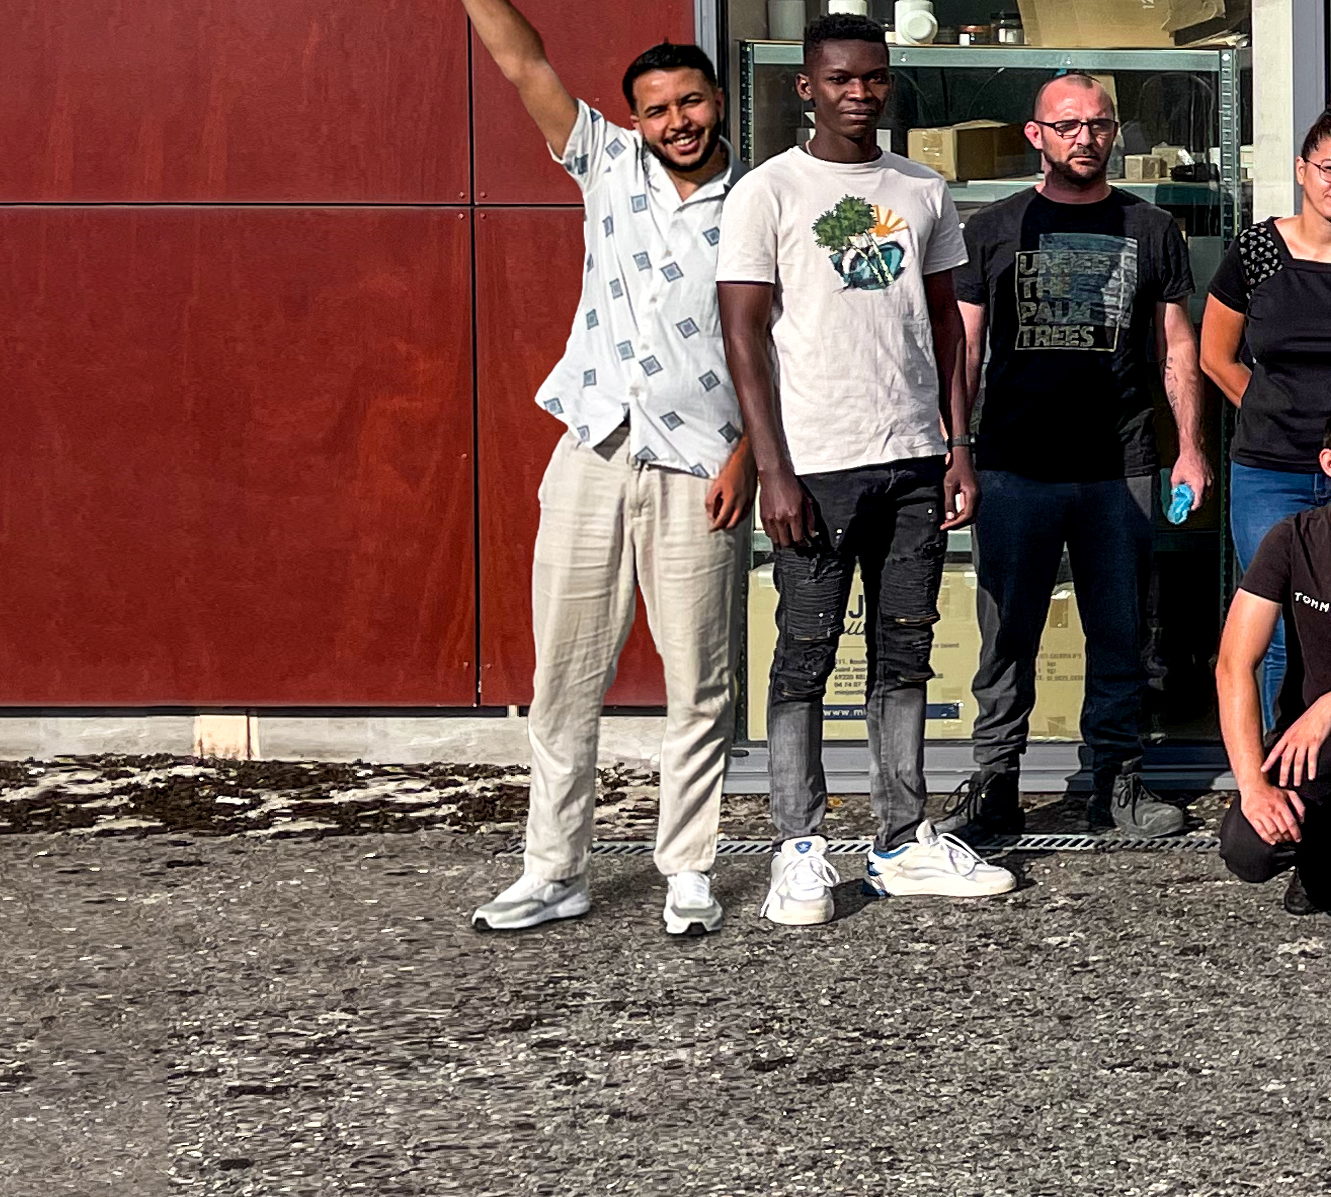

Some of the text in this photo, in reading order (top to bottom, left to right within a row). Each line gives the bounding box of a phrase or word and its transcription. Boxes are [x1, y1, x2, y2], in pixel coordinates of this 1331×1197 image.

[1019, 277, 1072, 298] THE
[1020, 302, 1091, 323] PALM
[1019, 325, 1094, 347] TREES
